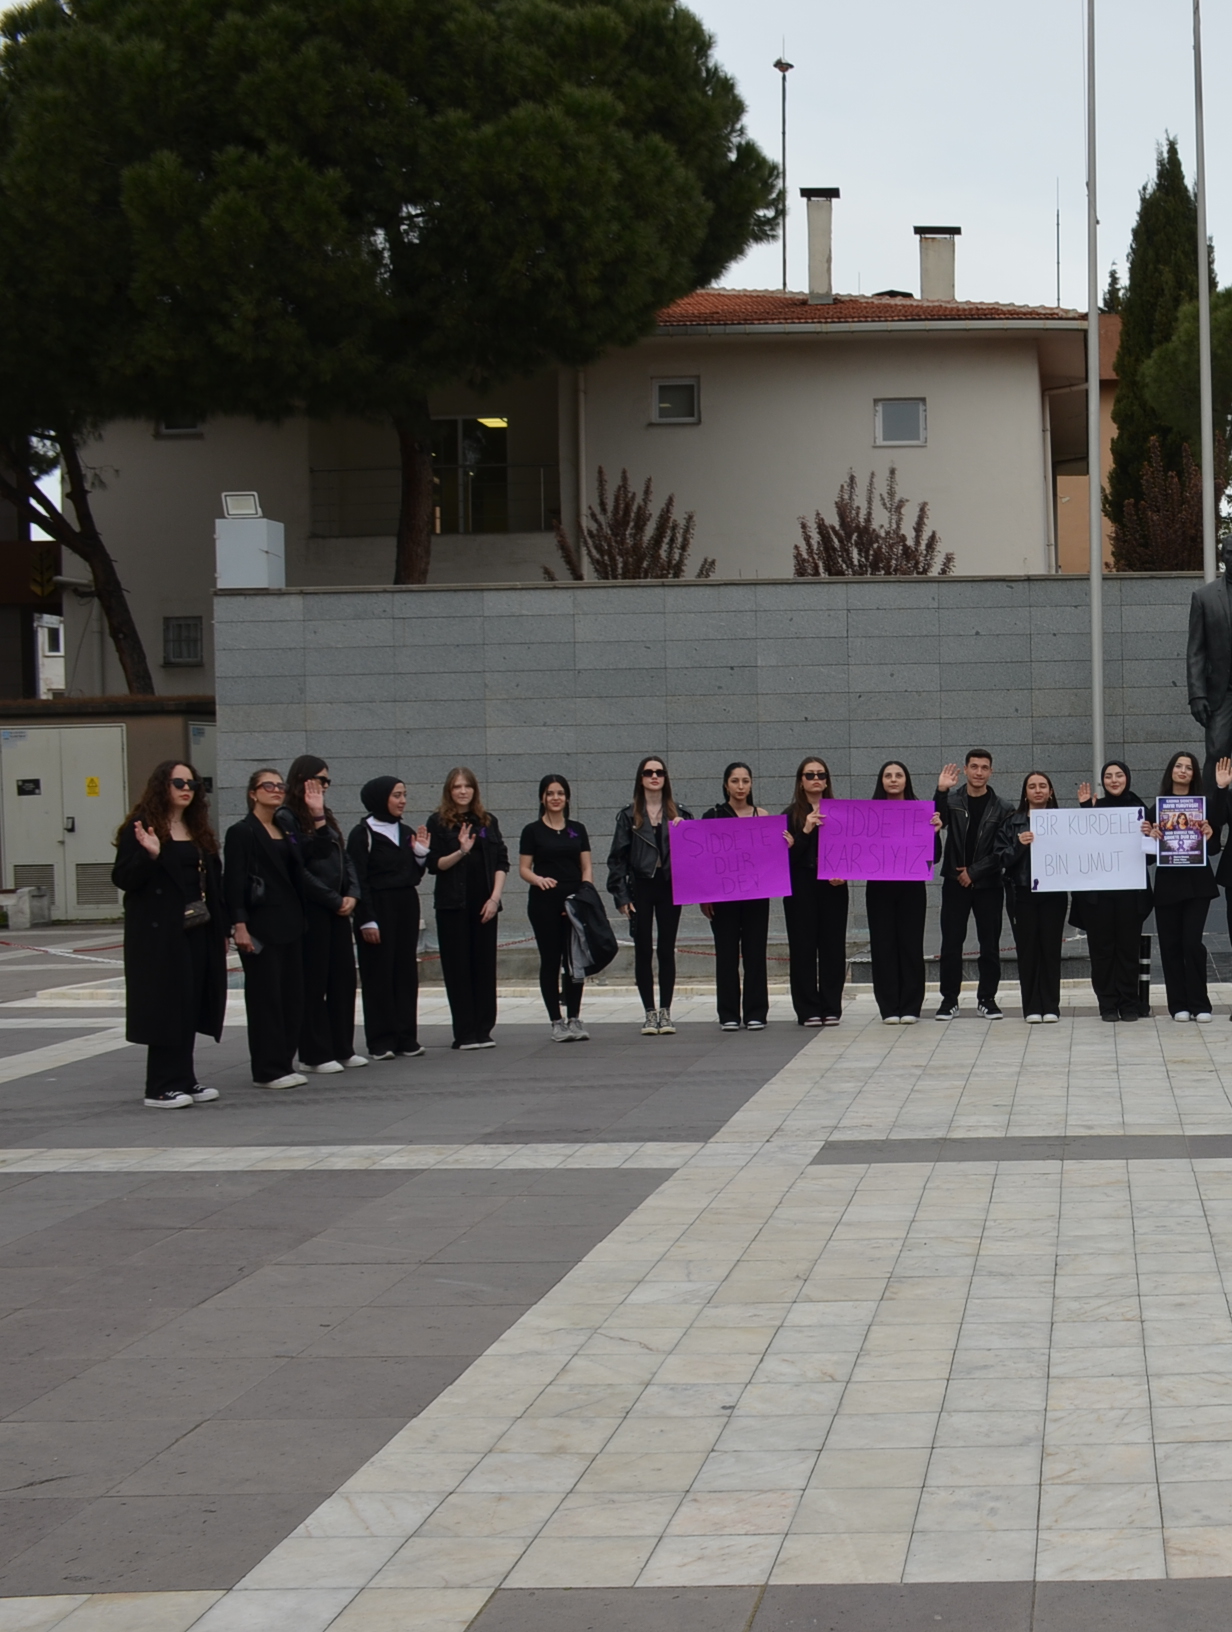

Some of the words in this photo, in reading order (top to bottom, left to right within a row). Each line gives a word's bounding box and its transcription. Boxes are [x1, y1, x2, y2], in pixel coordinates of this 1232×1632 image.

[1035, 812, 1058, 836] BİR
[1068, 812, 1137, 836] KURDELE
[714, 852, 754, 875] DUR
[1078, 850, 1124, 875] UMUT
